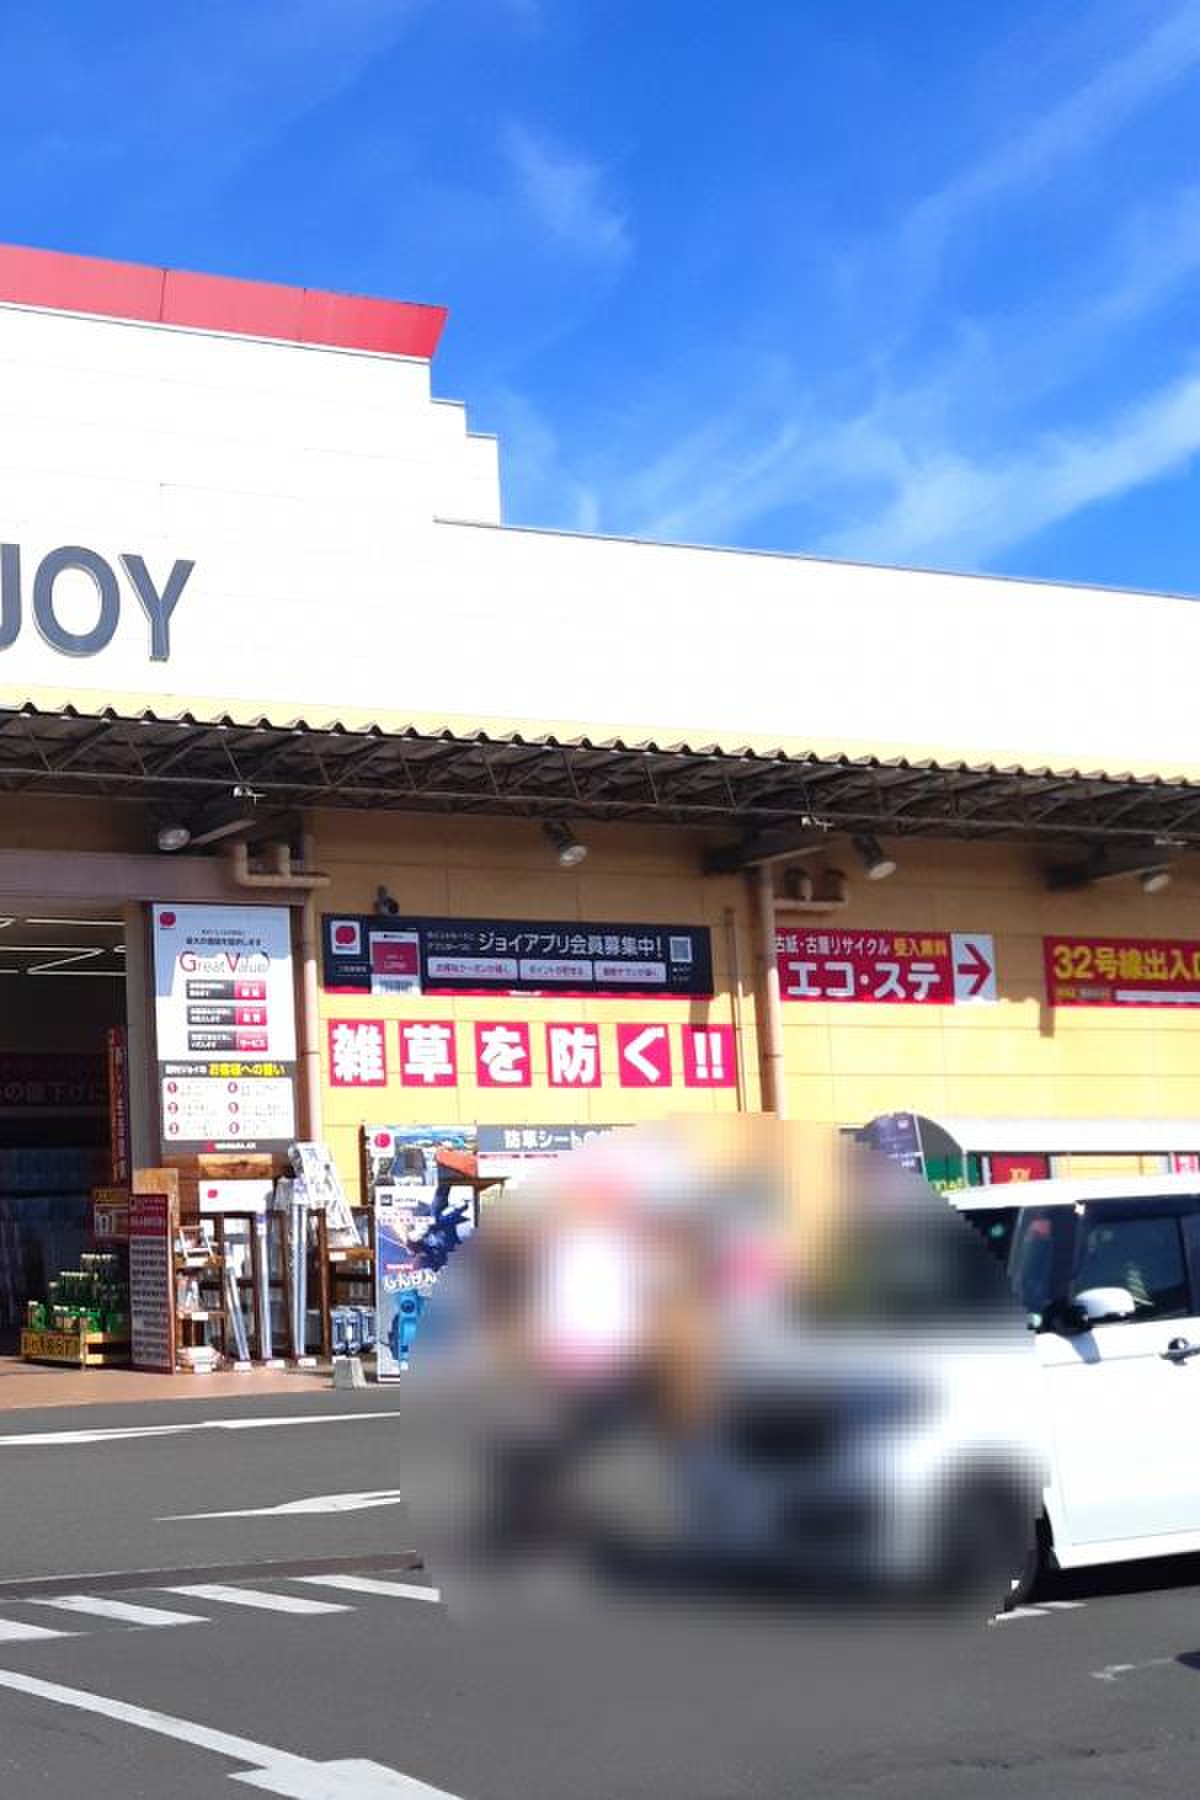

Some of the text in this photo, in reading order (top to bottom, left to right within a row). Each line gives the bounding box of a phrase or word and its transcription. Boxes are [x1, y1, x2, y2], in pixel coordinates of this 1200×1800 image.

[479, 933, 663, 957] ジョイアプリ会員募集中!
[787, 961, 941, 998] エコ・ステ
